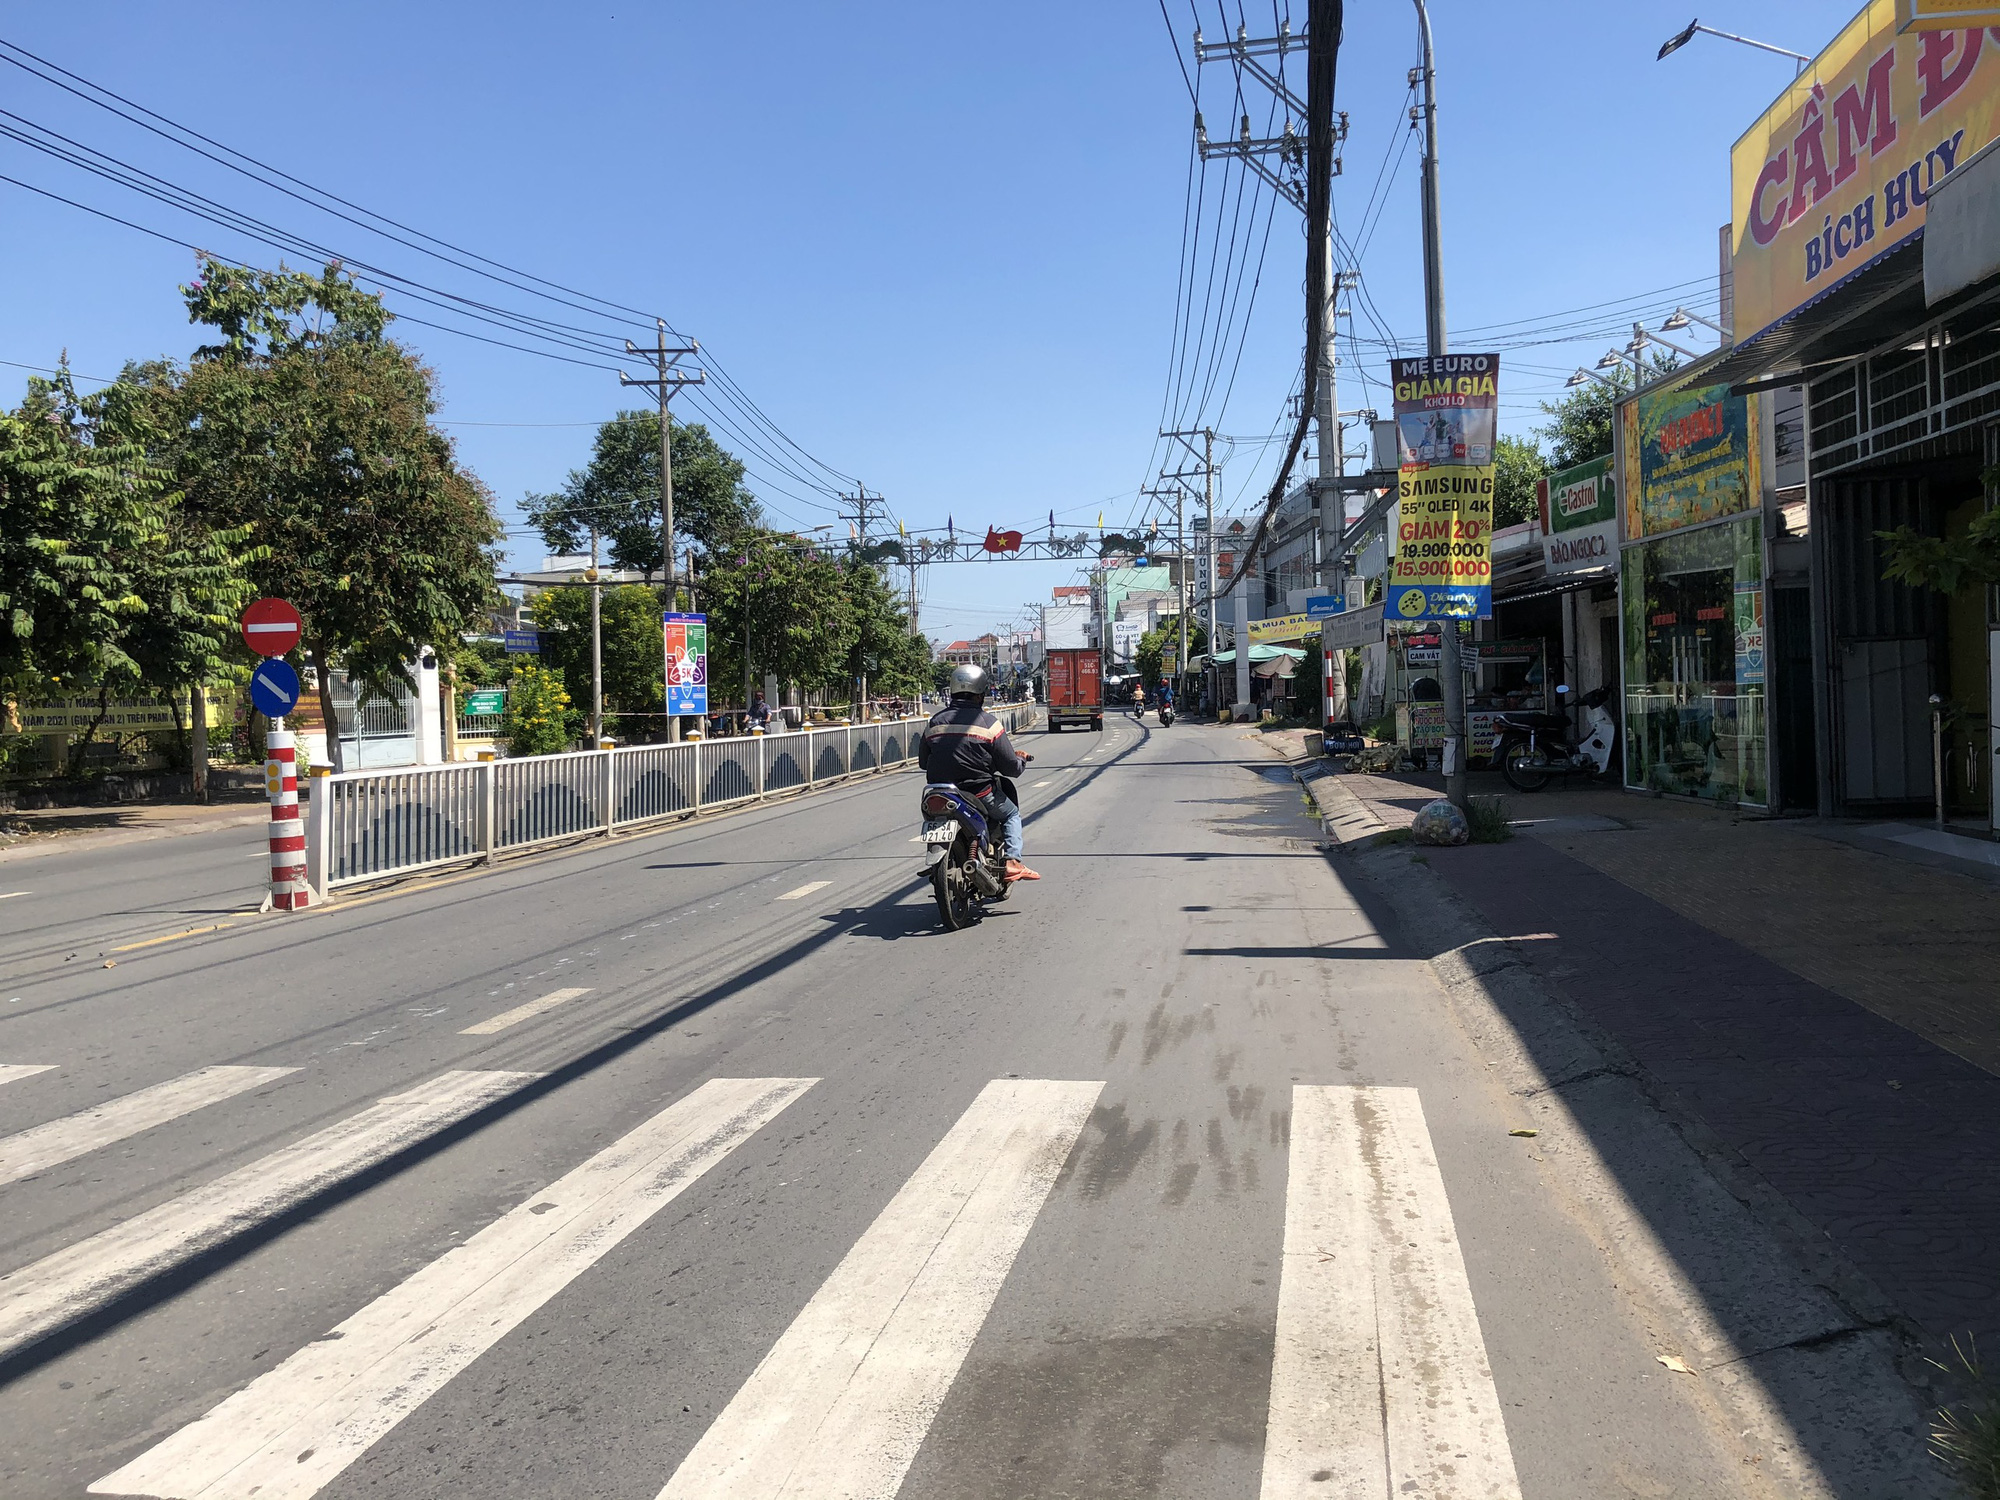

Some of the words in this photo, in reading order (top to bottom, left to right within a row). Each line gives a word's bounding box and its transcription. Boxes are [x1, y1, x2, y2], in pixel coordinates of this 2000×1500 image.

[1750, 45, 1897, 246] CẦM
[1917, 27, 2000, 119] Đ
[1805, 195, 1875, 282] BÍCH
[1884, 129, 1964, 228] HUY
[1402, 357, 1429, 377] MÊ
[1433, 356, 1488, 373] EURO
[1395, 374, 1452, 402] GIẢM
[1456, 371, 1496, 397] GIÁ
[1452, 396, 1465, 406] LO
[1400, 477, 1493, 497] SAMSUNG
[1567, 481, 1597, 512] Castrol
[1427, 499, 1459, 514] QLED
[1469, 500, 1491, 513] 4K
[1400, 515, 1450, 540] GIẢM
[1453, 519, 1491, 539] 20%
[1401, 542, 1485, 559] 19.900.000
[1396, 560, 1490, 576] 15.900.000
[1427, 602, 1478, 616] XANH
[1262, 620, 1286, 628] MUA
[1410, 652, 1425, 660] CAM
[682, 667, 692, 678] 5K
[47, 715, 67, 726] 2021
[922, 831, 953, 842] 021.40
